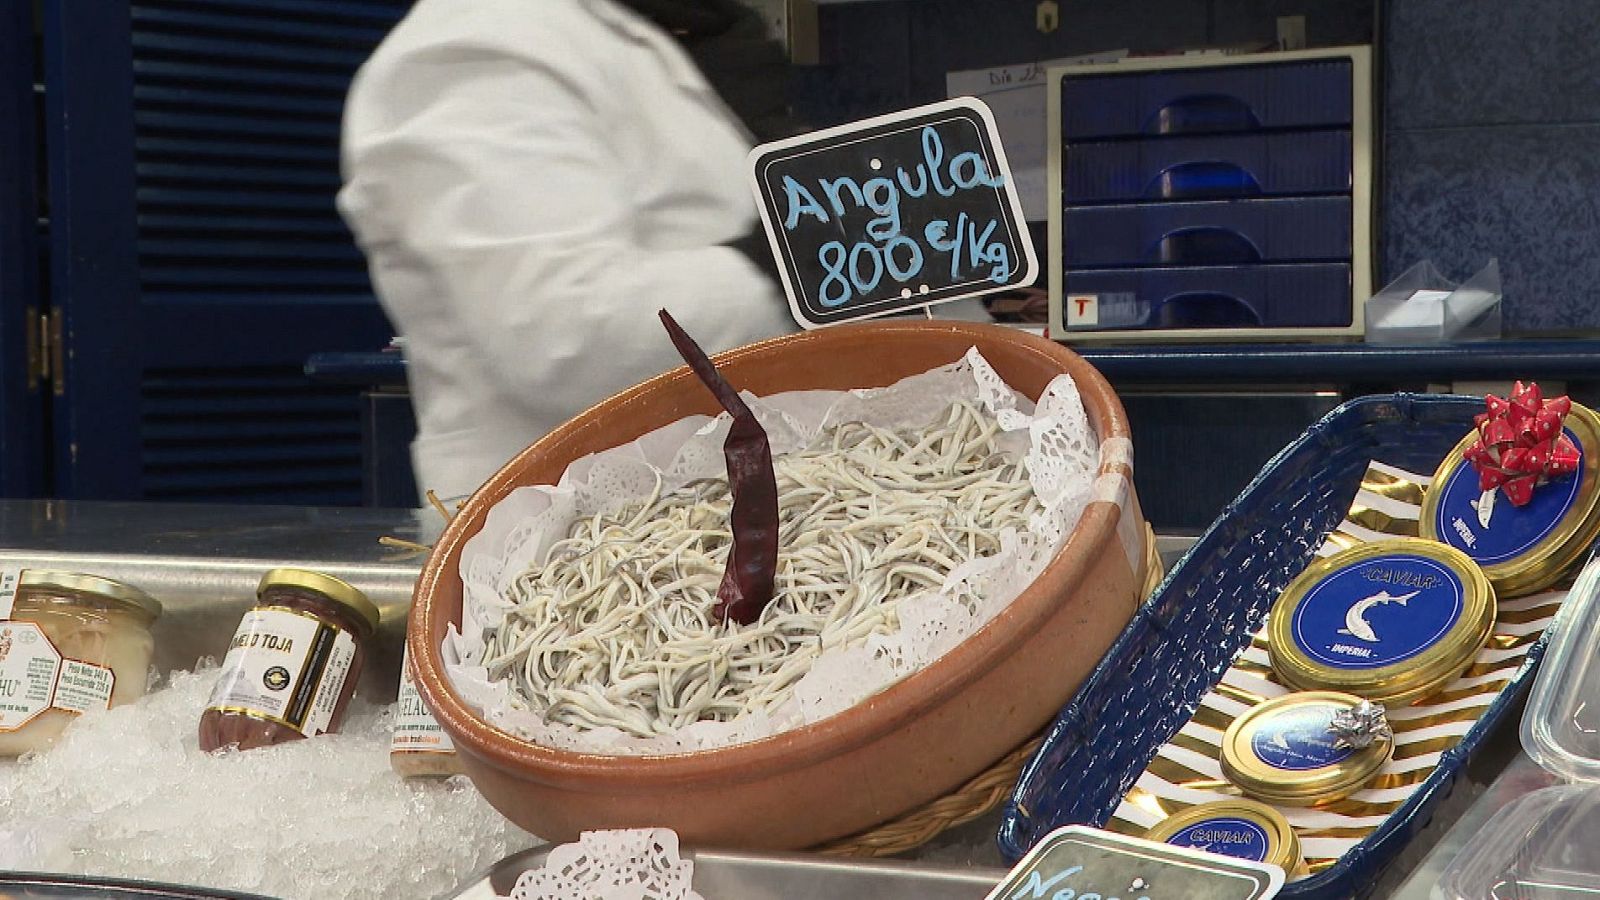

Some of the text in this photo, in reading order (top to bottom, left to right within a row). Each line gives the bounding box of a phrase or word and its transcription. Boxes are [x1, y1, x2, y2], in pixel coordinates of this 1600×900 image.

[782, 126, 1006, 242] Angula
[818, 236, 924, 307] 800
[1074, 298, 1092, 317] T
[260, 633, 294, 653] TOJA
[1330, 643, 1373, 659] IMPERIAL
[1189, 828, 1255, 845] CAVIAR
